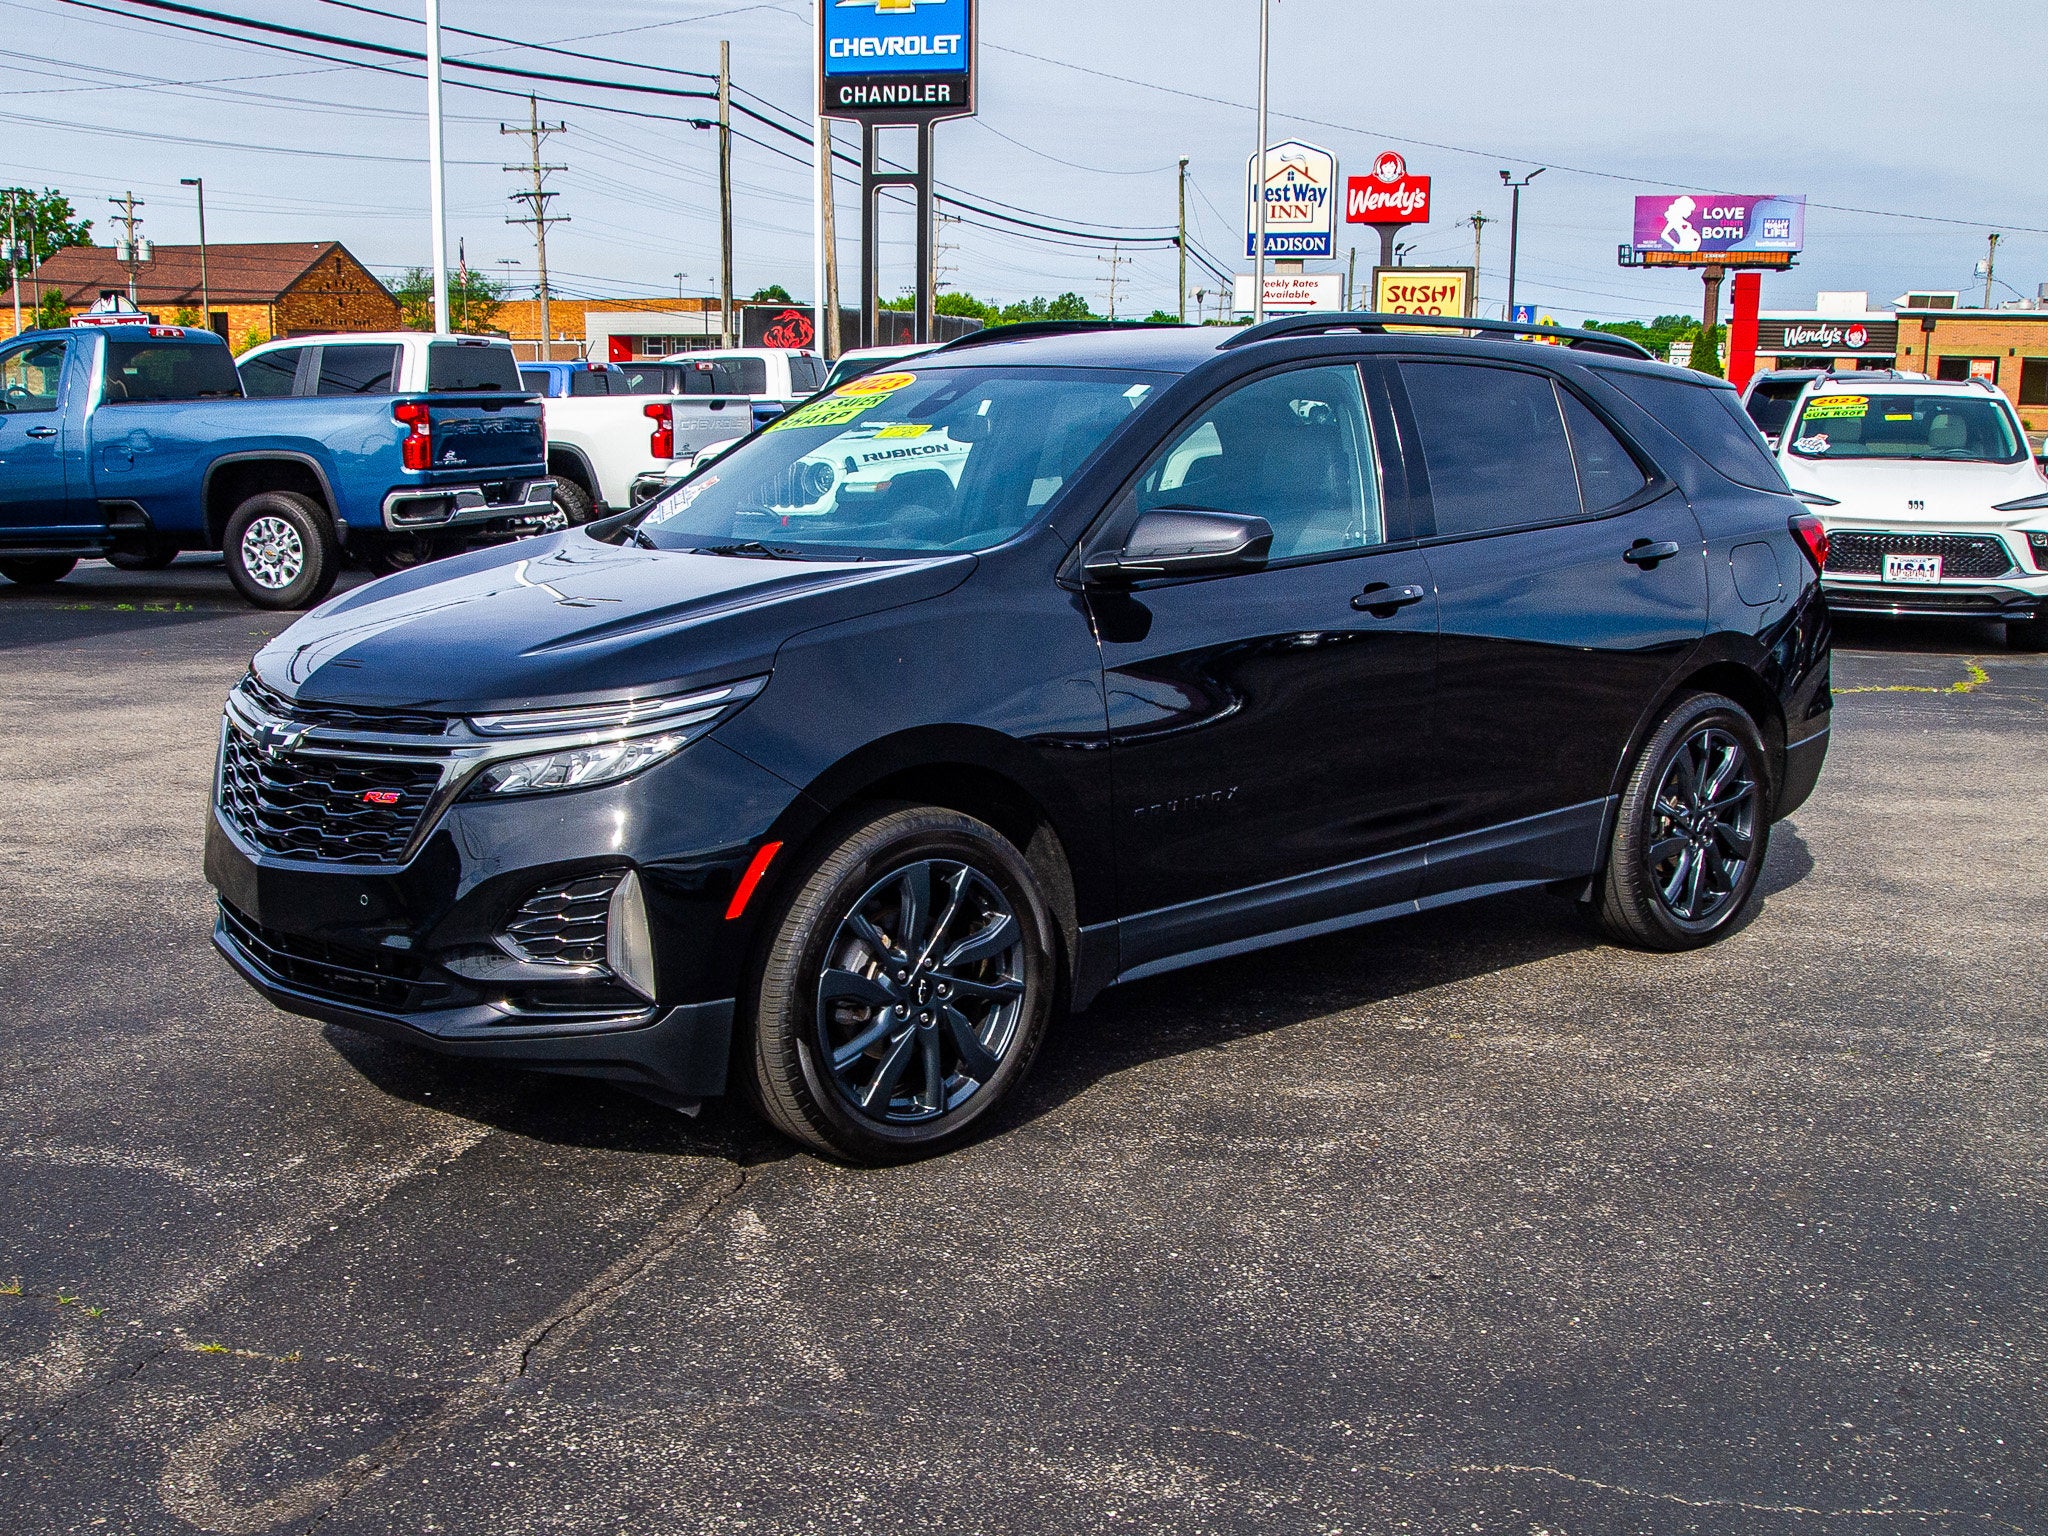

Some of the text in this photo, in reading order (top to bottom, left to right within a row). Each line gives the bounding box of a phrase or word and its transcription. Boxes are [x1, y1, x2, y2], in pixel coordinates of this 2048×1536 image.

[829, 34, 961, 58] CHEVROLET
[839, 84, 951, 104] CHANDLER
[1293, 183, 1328, 208] Way
[1349, 182, 1426, 217] Wendy's
[1270, 204, 1309, 219] INN
[1702, 207, 1745, 220] LOVE
[1701, 226, 1744, 240] BOTH
[1764, 228, 1789, 238] LIFE
[1262, 279, 1319, 289] eekly Rates
[1263, 290, 1310, 299] Available
[1387, 285, 1456, 303] SUSHI
[1783, 323, 1842, 348] Wendy's
[841, 377, 911, 392] 2023
[1819, 397, 1862, 405] 2024
[863, 443, 949, 463] RUBICON
[1890, 562, 1936, 577] USA1
[362, 791, 401, 804] RS
